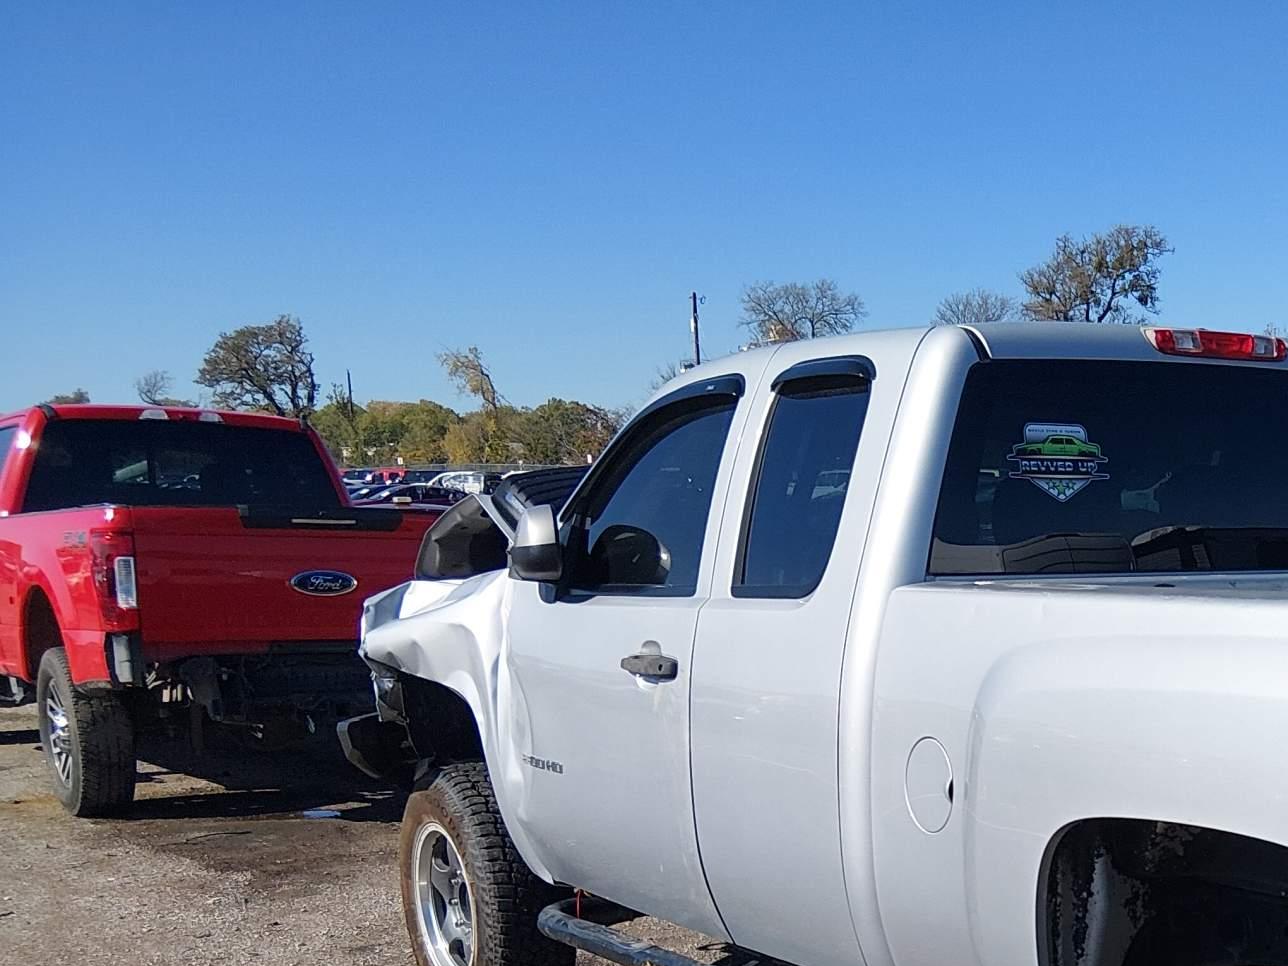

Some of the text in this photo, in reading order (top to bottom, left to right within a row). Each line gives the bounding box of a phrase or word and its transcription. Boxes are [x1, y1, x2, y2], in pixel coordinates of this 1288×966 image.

[1021, 460, 1096, 472] REVVED UP
[308, 575, 342, 590] Ford
